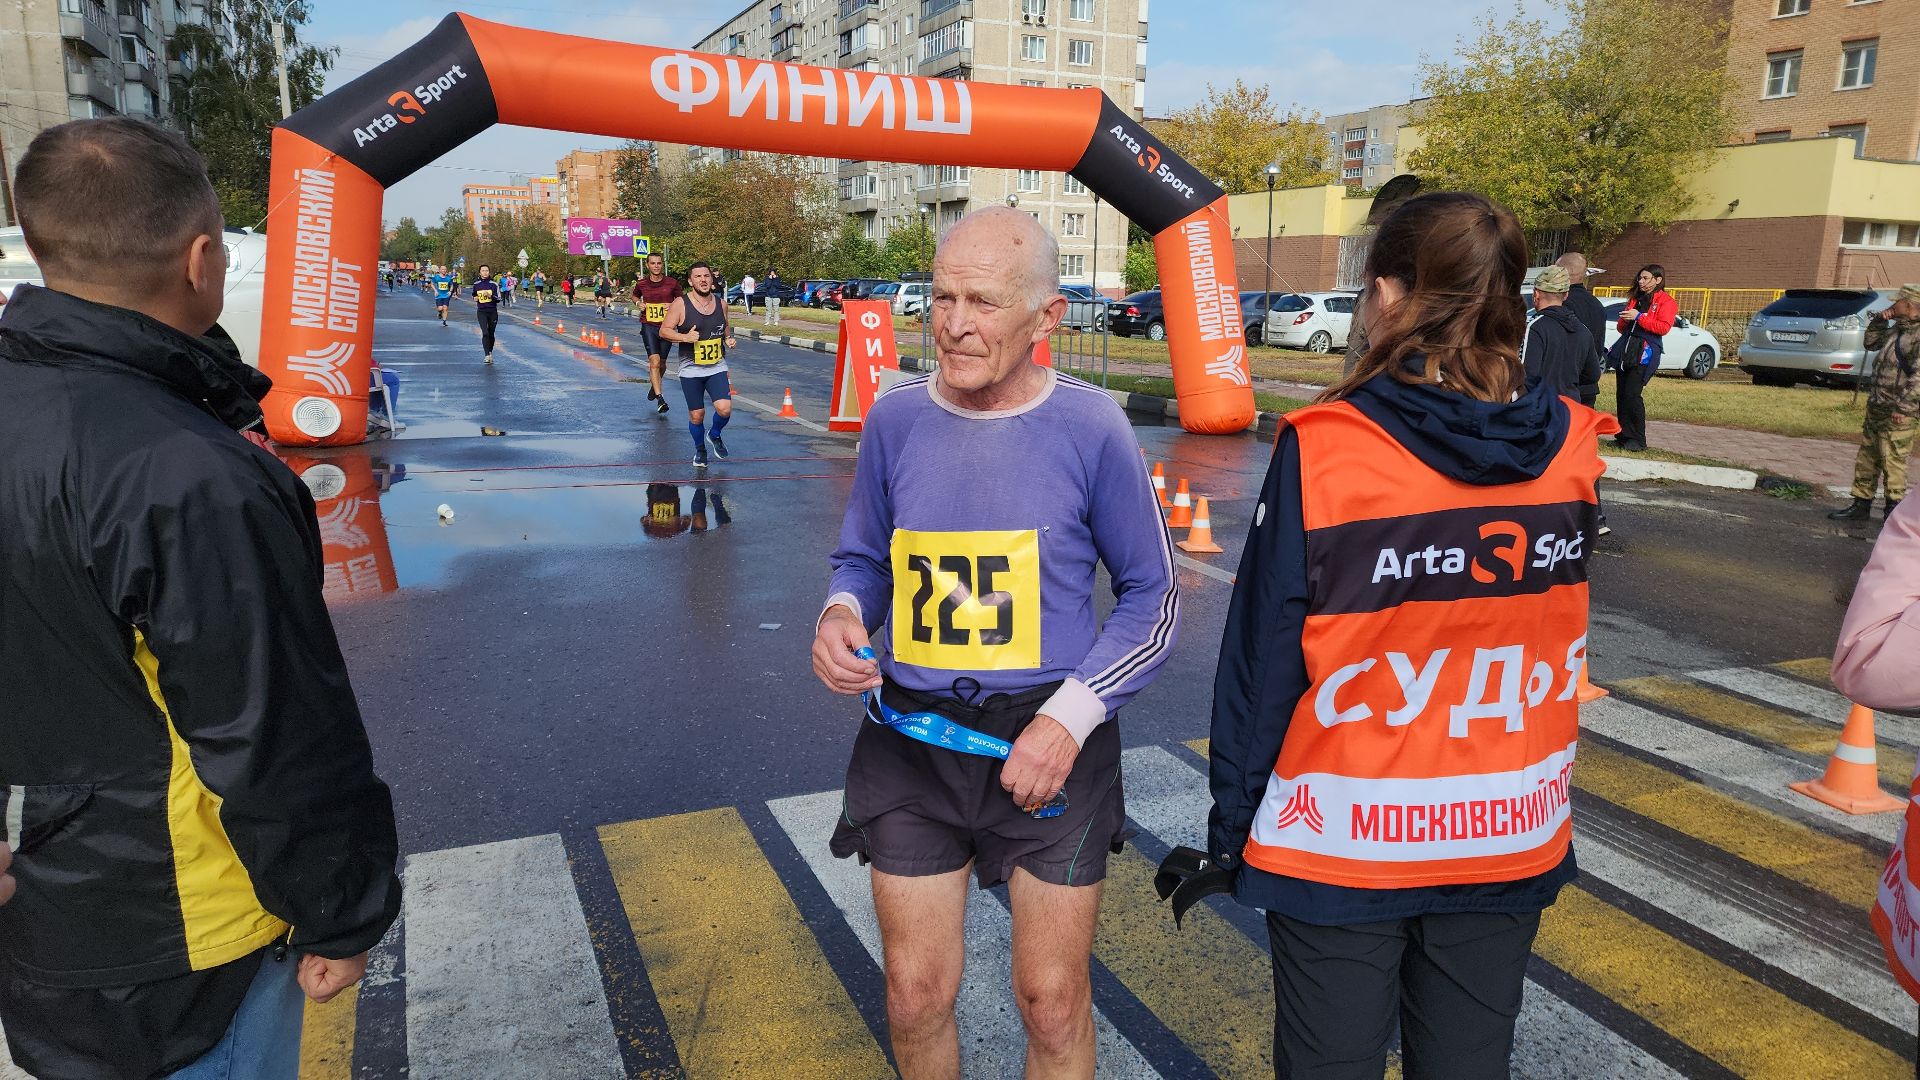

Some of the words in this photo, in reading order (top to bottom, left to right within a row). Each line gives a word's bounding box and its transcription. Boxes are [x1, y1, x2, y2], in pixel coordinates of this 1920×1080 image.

[353, 113, 398, 148] Arta
[414, 64, 467, 105] Sport
[651, 53, 972, 135] ФИНИШ
[1109, 124, 1141, 155] Arta
[1156, 163, 1195, 199] Sport
[290, 168, 336, 328] МОСКОВСКИЙ
[1181, 220, 1224, 341] МОСКОВСКИЙ
[327, 257, 362, 333] СПОРТ
[648, 306, 665, 319] 334
[1218, 282, 1242, 339] СПОРТ
[699, 343, 719, 361] 323
[908, 554, 1013, 646] 225
[1371, 544, 1465, 584] Arta
[1351, 778, 1549, 843] МОСКОВСКИЙ
